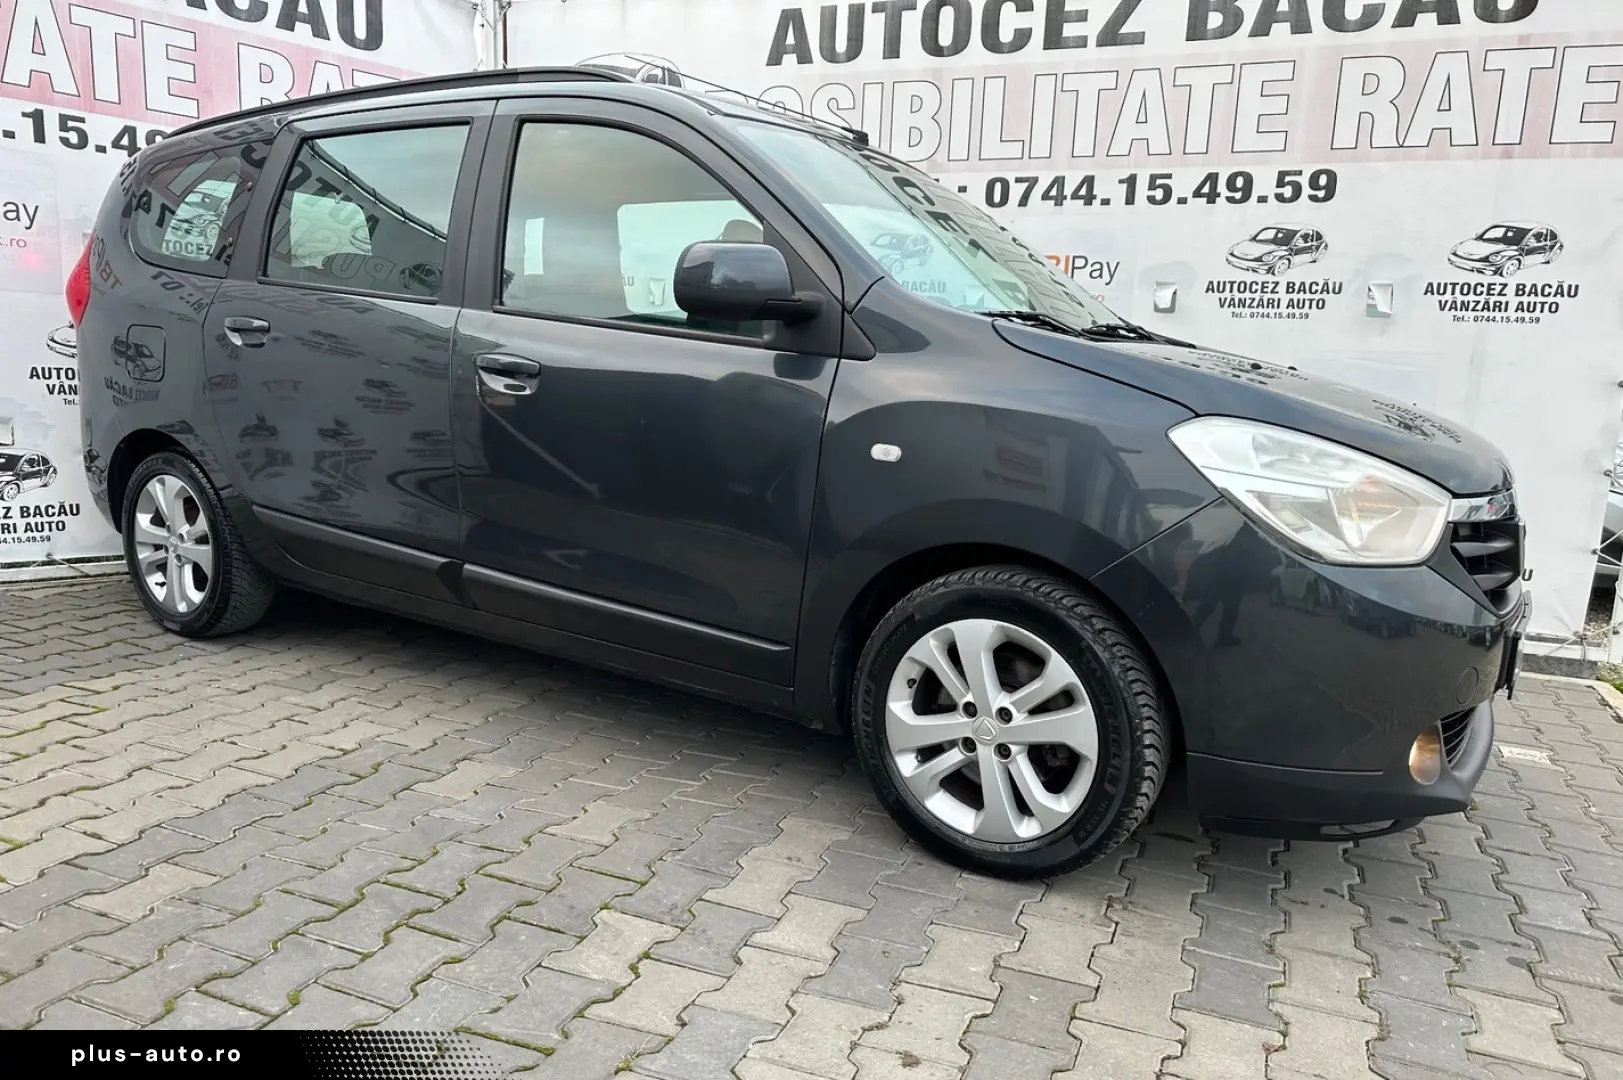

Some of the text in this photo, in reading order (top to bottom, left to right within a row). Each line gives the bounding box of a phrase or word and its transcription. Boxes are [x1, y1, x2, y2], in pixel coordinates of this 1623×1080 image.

[765, 0, 1146, 66] AUTOCEZ
[1330, 44, 1623, 150] RATE
[985, 169, 1338, 207] 0744.15.49.59
[1205, 278, 1343, 295] AUTOCEZ BACĂU
[1423, 280, 1579, 298] AUTOCEZ BACĂU
[1218, 294, 1326, 310] VÂNZĂRI AUTO
[1438, 297, 1560, 314] VÂNZĂRI AUTO
[1250, 311, 1309, 320] 0744.15.49.59
[1473, 315, 1541, 324] 0744.15.49.59
[20, 500, 80, 519] BACĂU
[24, 520, 66, 534] AUTO
